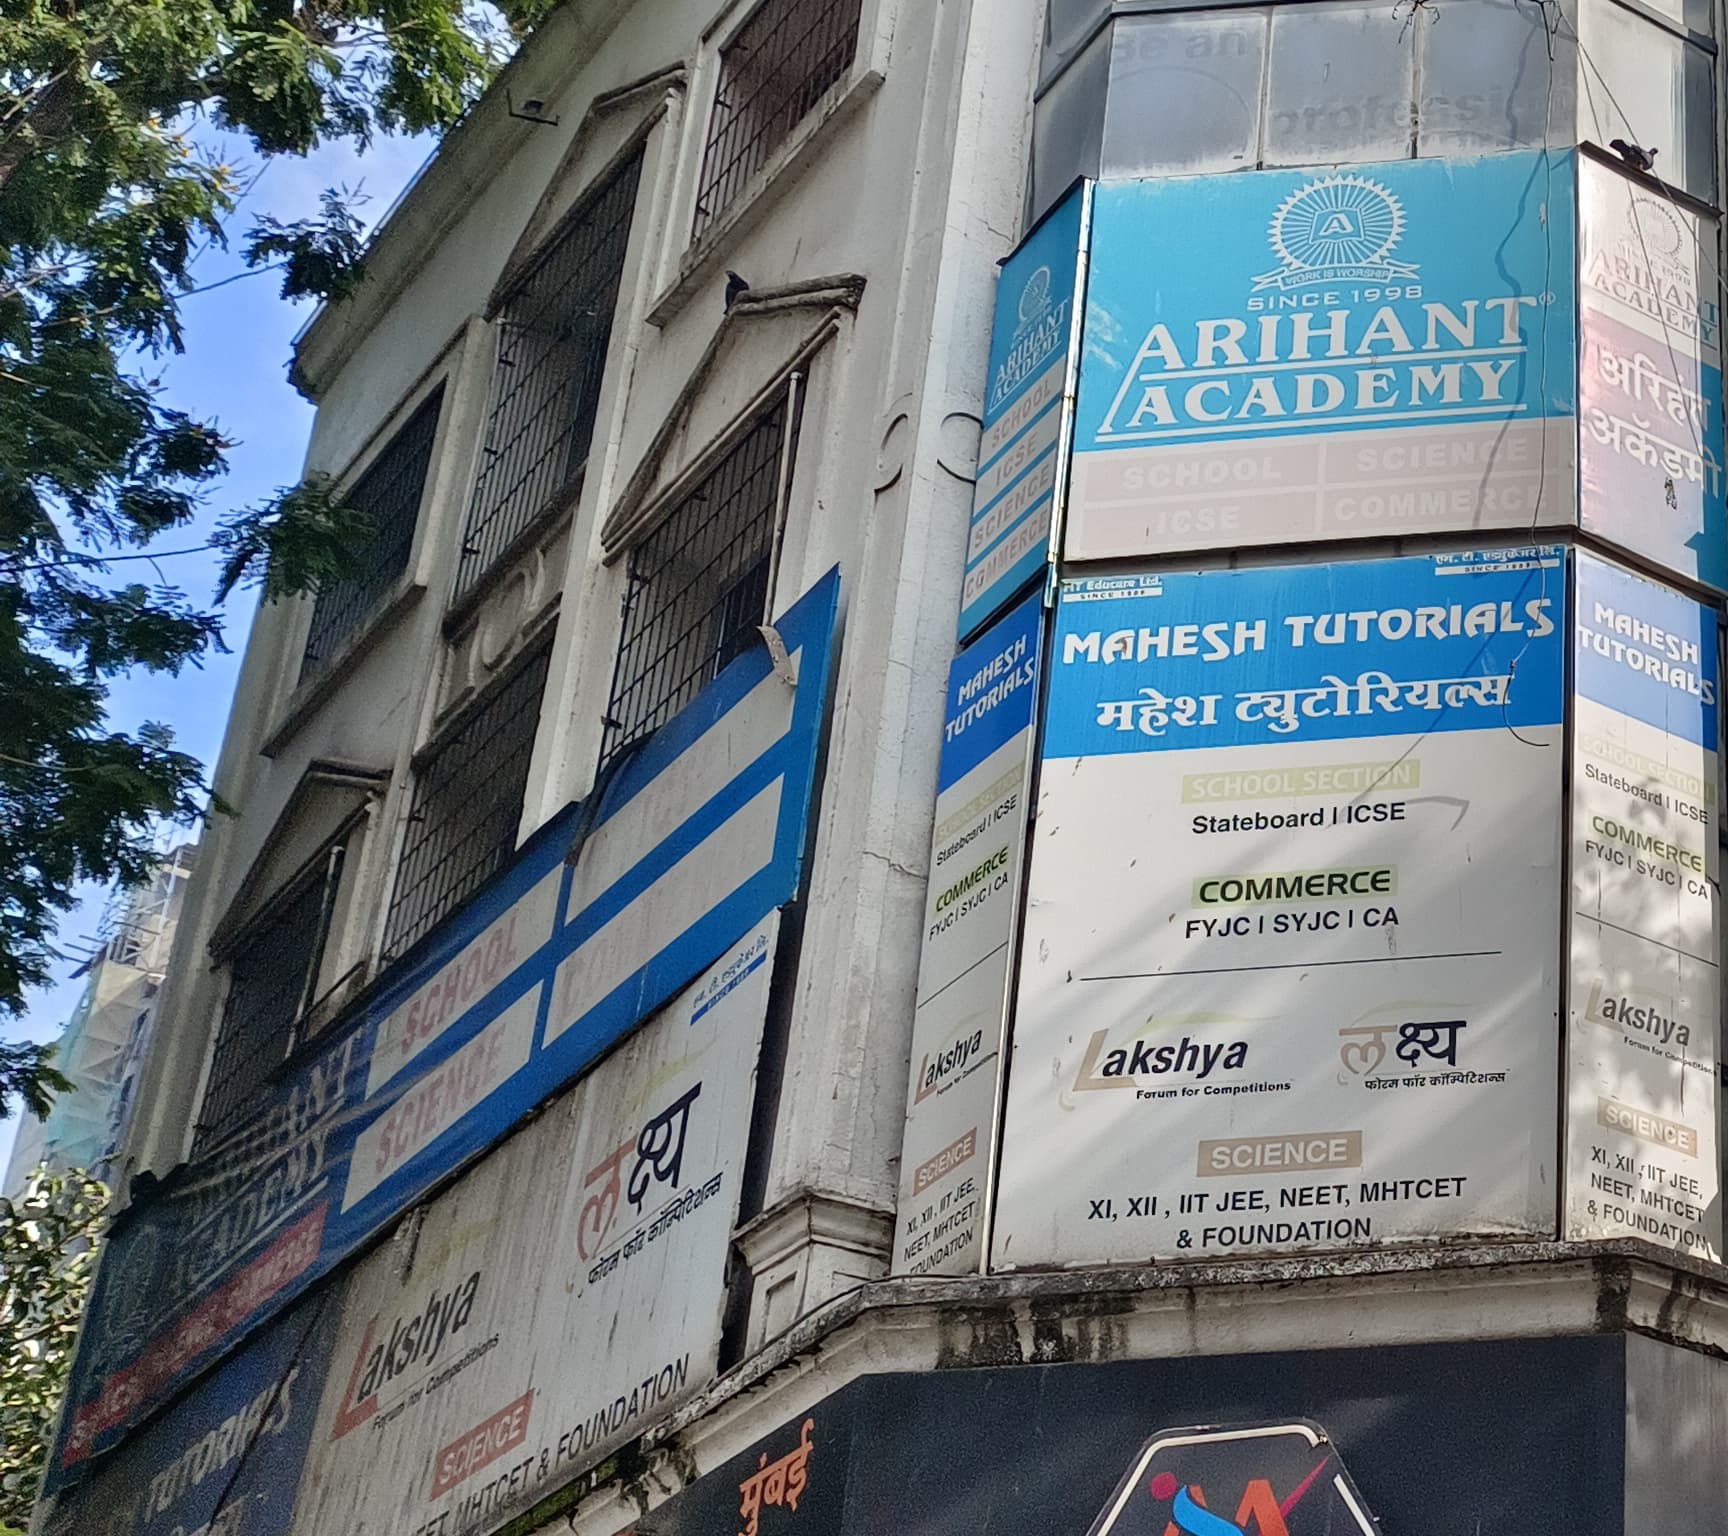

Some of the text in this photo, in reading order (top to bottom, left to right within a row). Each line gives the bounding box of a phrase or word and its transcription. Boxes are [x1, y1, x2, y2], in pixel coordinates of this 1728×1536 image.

[1247, 285, 1424, 312] SINCE 1998
[1285, 270, 1321, 286] WORK
[1335, 267, 1392, 282] WORSHIP
[996, 301, 1070, 383] ARIHANT
[1118, 296, 1538, 382] ARIHANT
[991, 332, 1061, 406] ACADEMY
[1125, 358, 1517, 429] ACADEMY
[990, 381, 1053, 450] SCHOOL
[994, 435, 1038, 487] ICSE
[1121, 437, 1528, 491] SCHOOL SCIENCE
[973, 465, 1050, 549] SCIENCE
[1157, 482, 1548, 534] ICSE COMMERCE
[965, 510, 1049, 600] COMMERCE
[1062, 598, 1555, 665] MAHESH TUTORIALS
[1594, 602, 1699, 665] MAHESH
[956, 633, 1027, 707] MAHESH
[1578, 626, 1716, 706] TUTORIALS
[945, 655, 1035, 743] TUTORIALS
[1095, 687, 1224, 737] महेश
[1583, 734, 1643, 772] SCHOOL
[993, 794, 1018, 823] ICSE
[1190, 764, 1411, 801] SCHOOL SECTION
[1584, 762, 1709, 825] Stateboard ICSE
[1191, 801, 1406, 835] Stateboard ICSE
[1592, 815, 1703, 873] COMMERCE
[935, 846, 1009, 913] COMMERCE
[993, 871, 1009, 892] CA
[1198, 869, 1391, 904] COMMERCE
[1585, 840, 1708, 901] FYJC SYJC CA
[1185, 906, 1400, 940] FYJC SYJC CA
[400, 915, 519, 1056] SCHOOL
[1584, 978, 1691, 1046] Lakshya
[913, 1028, 984, 1106] Lakshya
[1071, 1028, 1250, 1092] Lakshya
[1337, 1019, 1468, 1077] लक्ष्य
[375, 1022, 507, 1175] SCIENCE
[1135, 1080, 1292, 1101] Forum for Competitions
[1209, 1138, 1349, 1170] SCIENCE
[1605, 1104, 1690, 1150] SCIENCE
[576, 1081, 703, 1263] लक्ष्य
[917, 1136, 973, 1188] SCIENCE
[1591, 1146, 1704, 1199] XI, IIT JEE,
[1087, 1176, 1468, 1223] XI, IIT JEE, NEET, MHTCET
[1591, 1172, 1705, 1223] NEET, MHTCET
[1176, 1217, 1372, 1249] & FOUNDATION
[1602, 1203, 1706, 1251] FOUNDATION
[555, 1352, 691, 1466] FOUNDATION
[439, 1405, 524, 1486] SCIENCE
